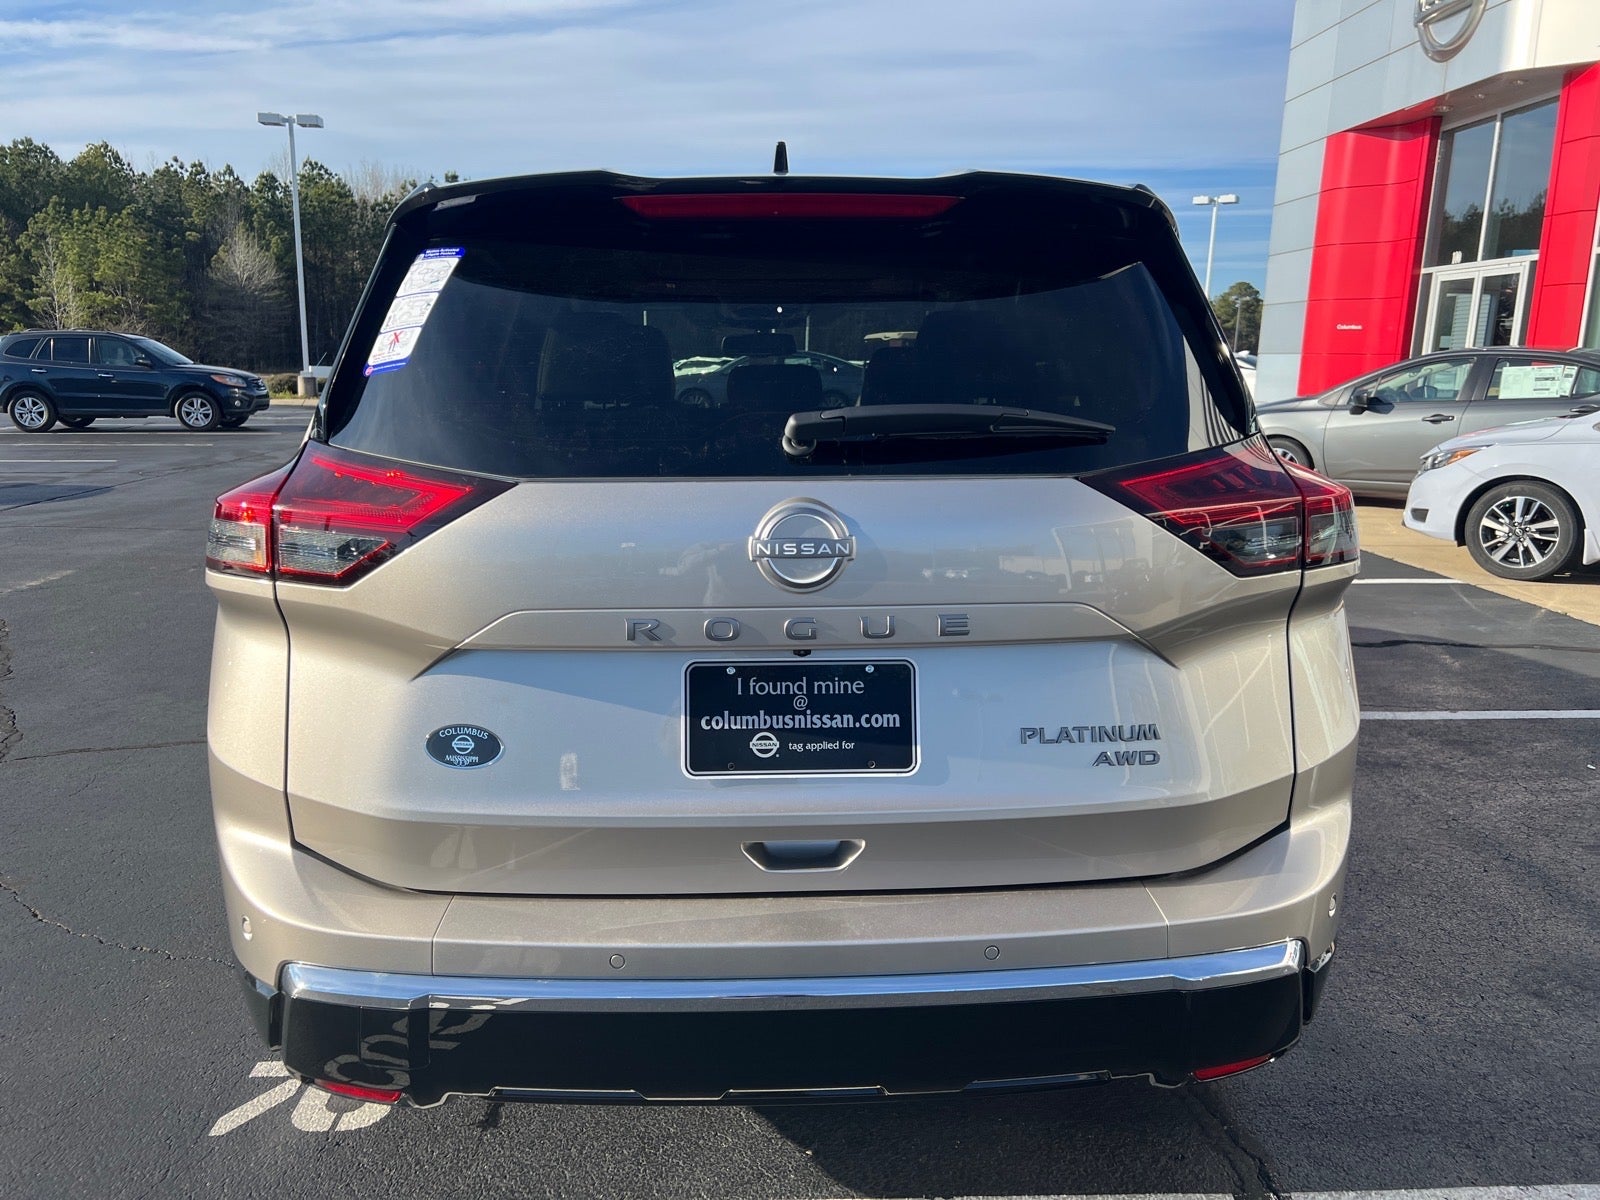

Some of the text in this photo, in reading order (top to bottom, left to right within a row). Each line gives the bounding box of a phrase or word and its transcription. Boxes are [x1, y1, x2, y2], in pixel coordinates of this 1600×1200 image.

[755, 542, 851, 558] NISSAN
[624, 613, 971, 641] ROGUE
[737, 677, 865, 695] I found mine
[793, 695, 808, 710] @
[700, 710, 901, 730] columbusnissan.com
[439, 727, 489, 740] COLUMBUS
[1020, 723, 1161, 745] PLATINUM
[788, 741, 856, 752] tag applied for
[1092, 750, 1161, 767] AWD
